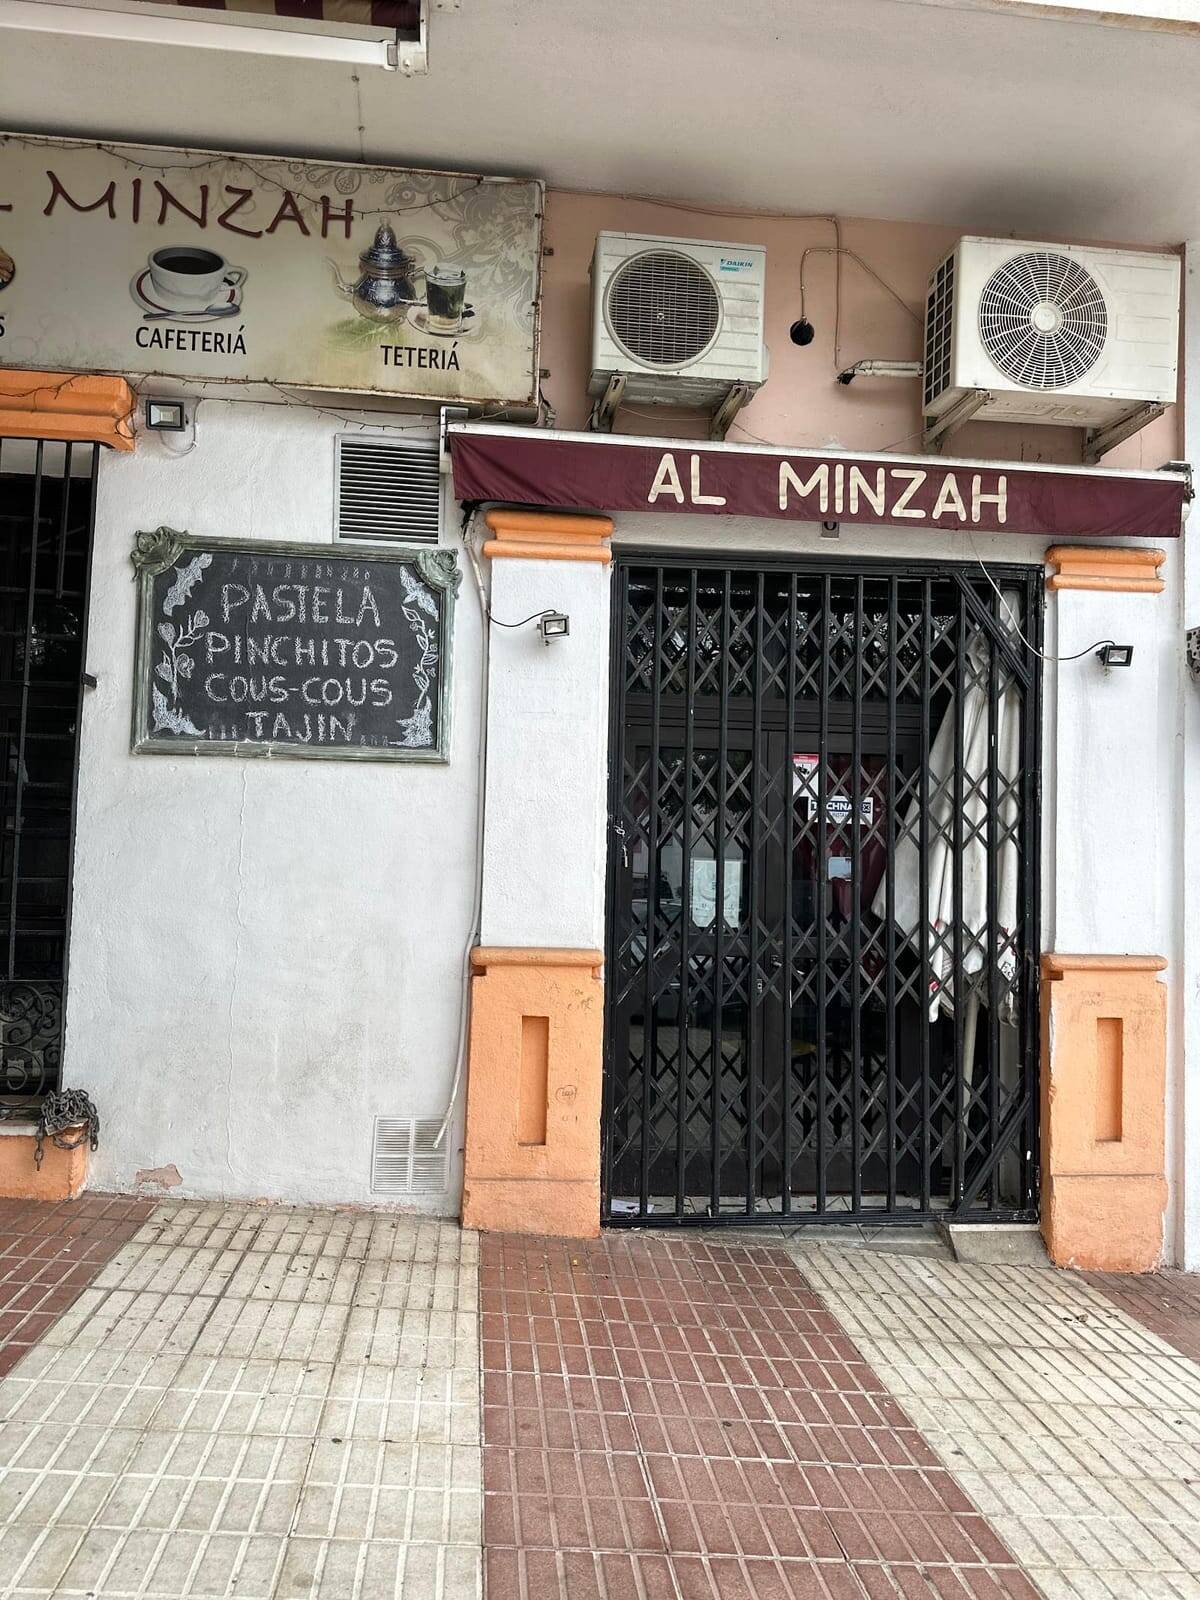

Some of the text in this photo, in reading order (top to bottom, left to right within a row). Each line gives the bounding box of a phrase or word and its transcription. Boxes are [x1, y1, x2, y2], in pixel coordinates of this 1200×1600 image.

[43, 170, 354, 239] MINZAH
[727, 260, 753, 268] DAIKIN
[135, 326, 247, 356] CAFETERIÁ
[380, 342, 460, 372] TETERIÁ
[647, 453, 1007, 524] AL MINZAH
[221, 583, 381, 627] PASTELA
[206, 631, 399, 669] PINCHITOS
[204, 673, 393, 706] COUS-COUS
[246, 711, 356, 742] TAJIN
